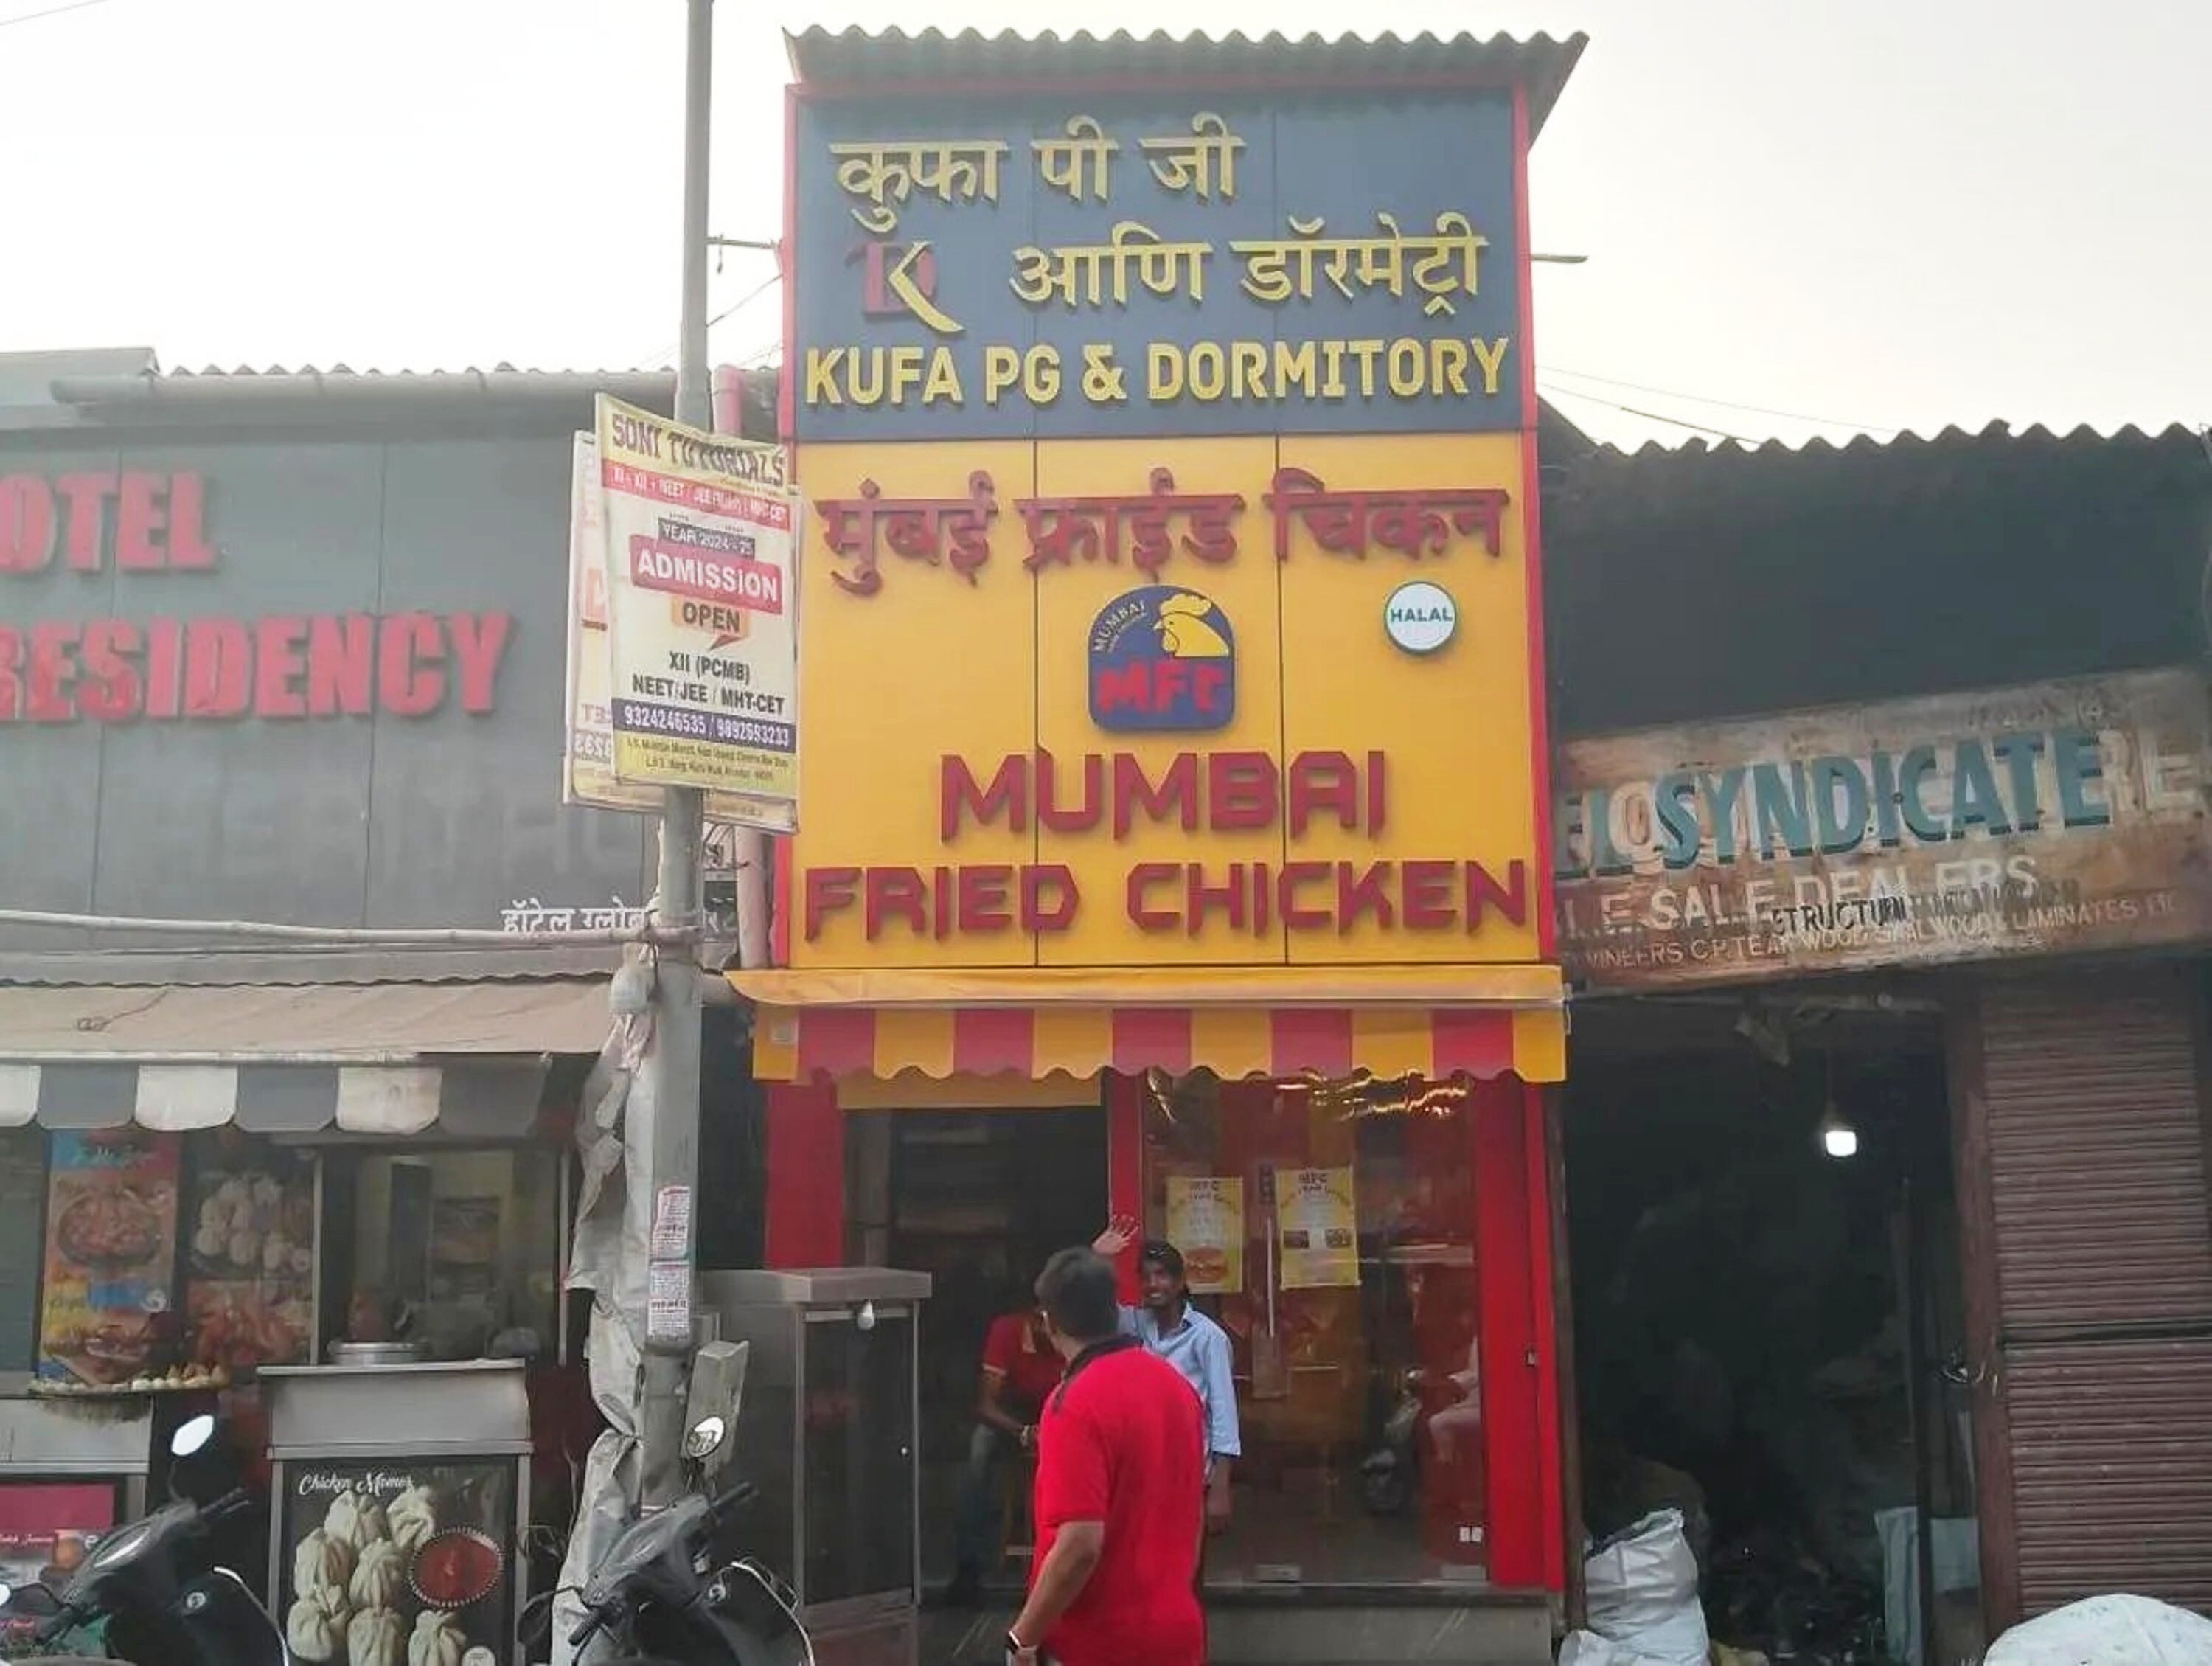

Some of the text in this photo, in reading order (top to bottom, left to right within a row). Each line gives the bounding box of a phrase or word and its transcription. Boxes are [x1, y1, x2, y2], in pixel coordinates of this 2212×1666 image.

[830, 111, 1245, 235] कुफा पी जी
[1009, 220, 1213, 307] आणि
[805, 336, 1509, 406] KUFA PG & DORMITORY
[814, 469, 998, 595] मुंबई
[1265, 467, 1511, 560] चिकन
[682, 601, 740, 633] OPEN
[1389, 606, 1454, 624] HALAL
[669, 650, 751, 686] XII (PCMB)
[941, 746, 1386, 843] MUMBAI
[1655, 732, 2112, 870] SYNDICATE
[804, 864, 1081, 942] FRIED
[1127, 858, 1526, 938] CHICKEN
[299, 1473, 351, 1496] Chicken
